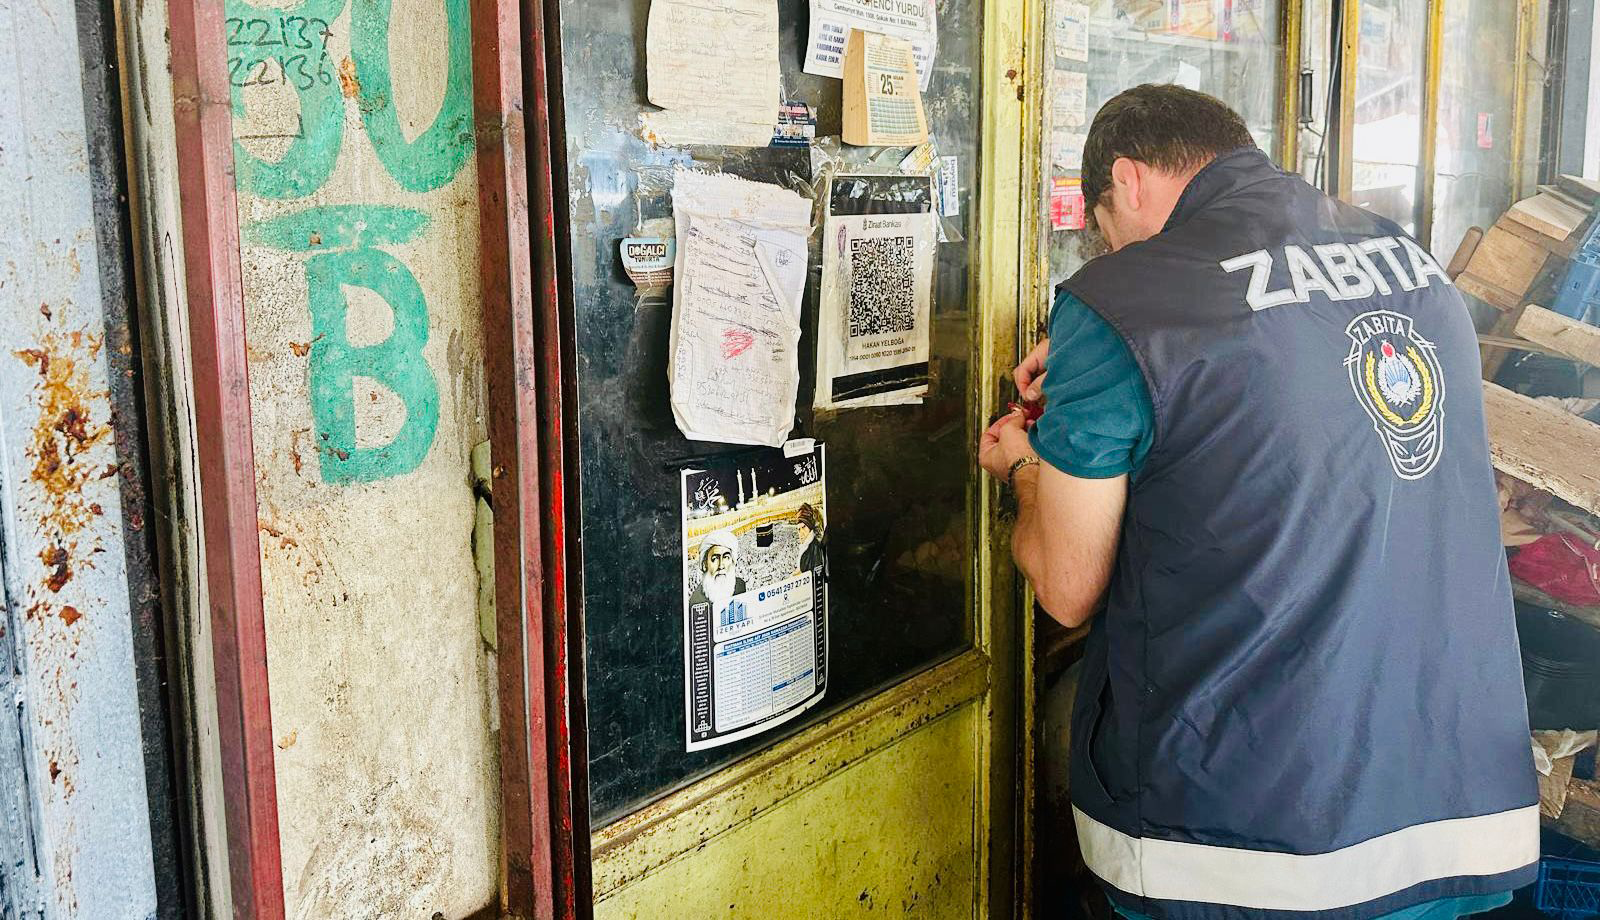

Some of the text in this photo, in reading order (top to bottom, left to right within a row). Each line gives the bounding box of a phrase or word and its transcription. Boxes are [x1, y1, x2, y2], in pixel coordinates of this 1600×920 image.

[896, 2, 924, 17] YURDU
[881, 74, 893, 95] 25
[868, 220, 881, 228] Ziraat
[1219, 236, 1452, 312] ZABITA
[1353, 316, 1406, 345] ZABITA
[862, 336, 905, 349] HAKAN YELBOĞA
[767, 576, 810, 598] 0541 297 27 20
[736, 619, 754, 628] YAPI
